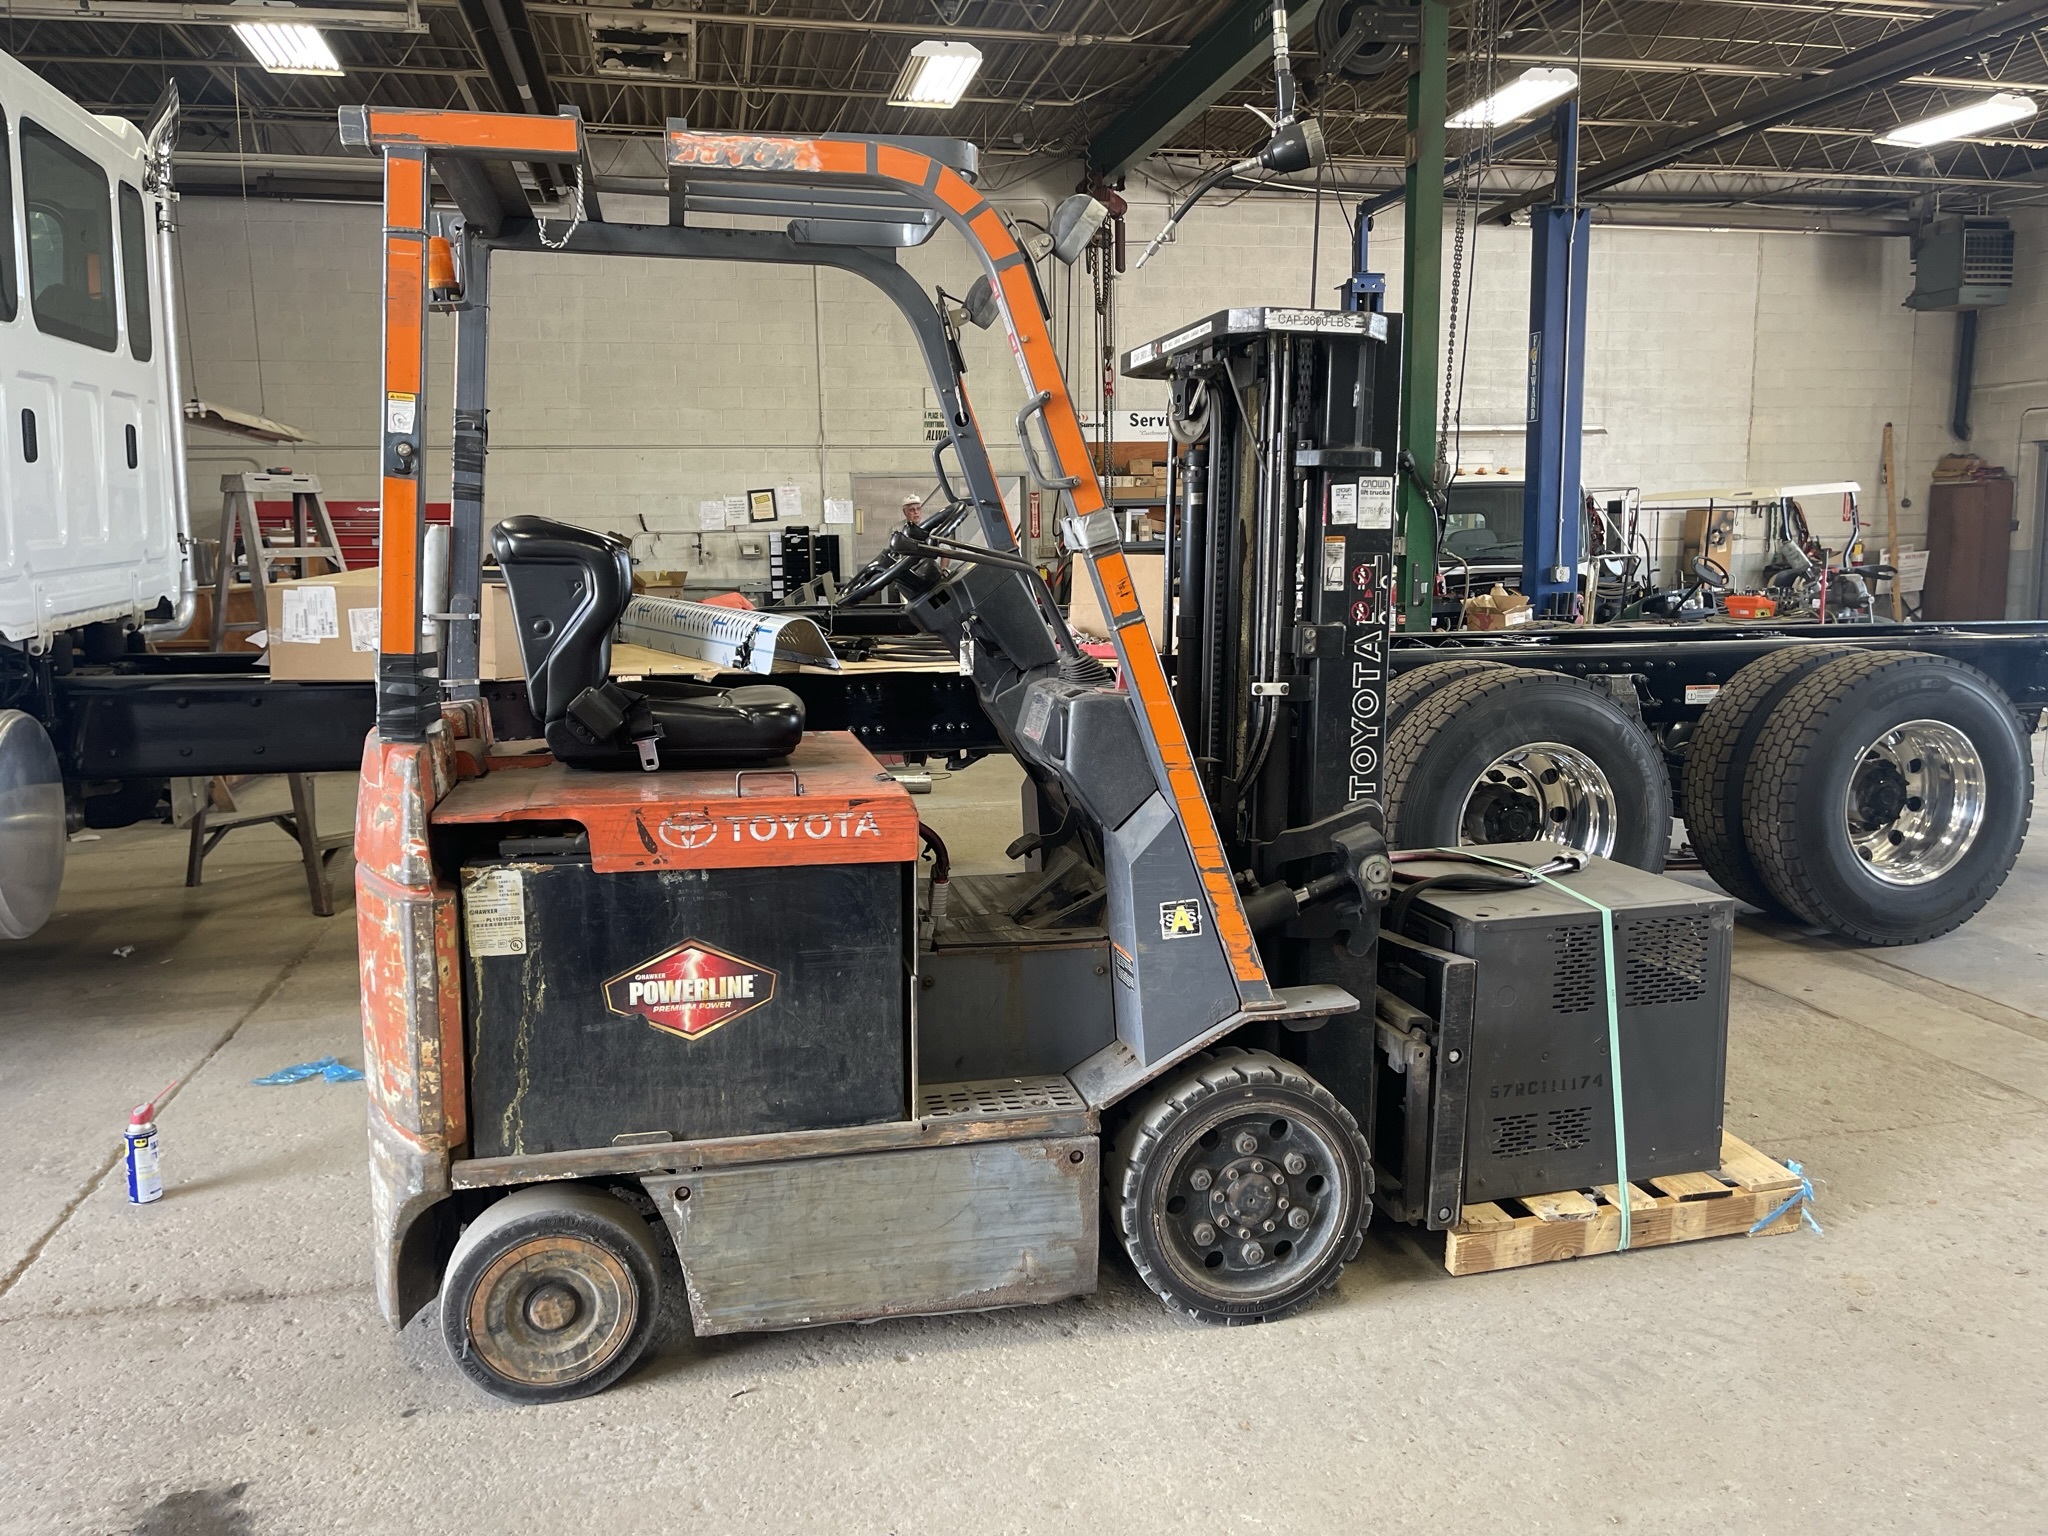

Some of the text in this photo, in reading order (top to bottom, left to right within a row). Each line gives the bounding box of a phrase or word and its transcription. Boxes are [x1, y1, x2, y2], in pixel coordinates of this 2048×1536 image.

[1348, 629, 1383, 802] TOYOTA
[724, 811, 882, 842] TOYOTA
[629, 974, 755, 1006] POWERLINE
[699, 1001, 732, 1010] POWER
